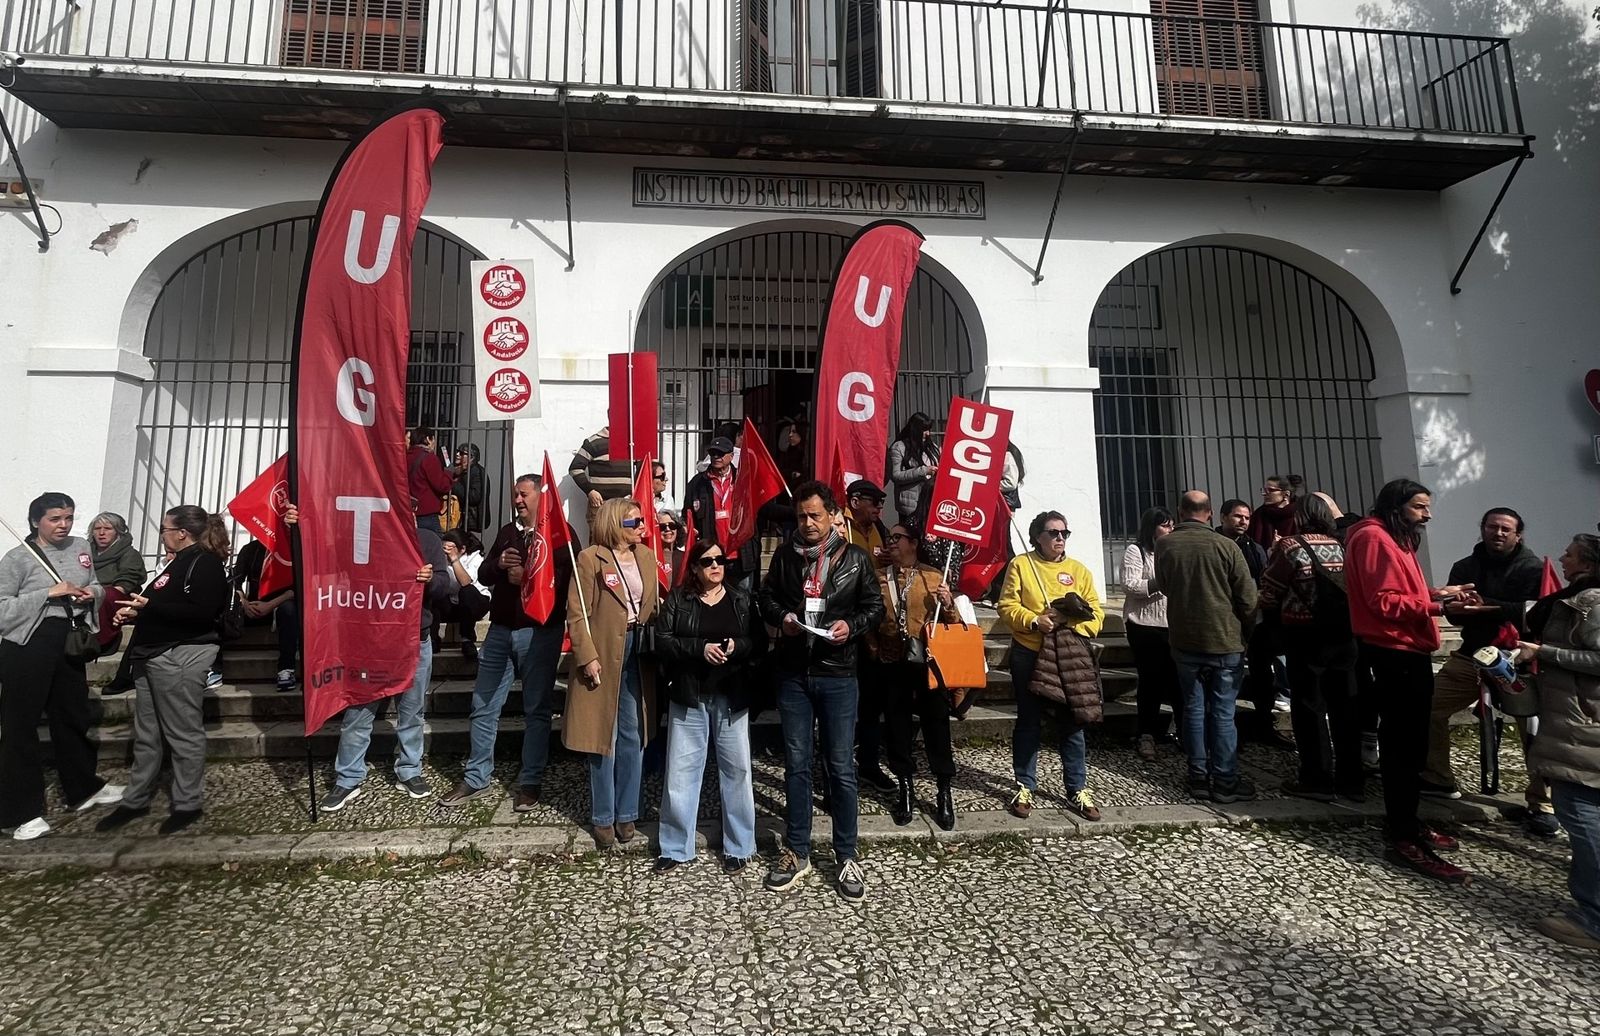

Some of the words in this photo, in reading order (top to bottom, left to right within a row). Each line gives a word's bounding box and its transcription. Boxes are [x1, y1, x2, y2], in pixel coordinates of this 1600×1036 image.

[640, 173, 734, 204] INSTITUTO
[755, 178, 891, 210] BACHILLERATO
[895, 183, 931, 212] SAN
[936, 184, 980, 214] BLAS
[489, 269, 516, 283] UGT
[492, 320, 519, 334] UGT
[335, 209, 400, 565] UGT
[494, 372, 521, 385] UGT
[949, 406, 999, 503] UGT
[938, 503, 957, 516] UGT
[961, 508, 976, 519] FSP
[317, 585, 406, 611] Huelva
[312, 666, 344, 689] UGT
